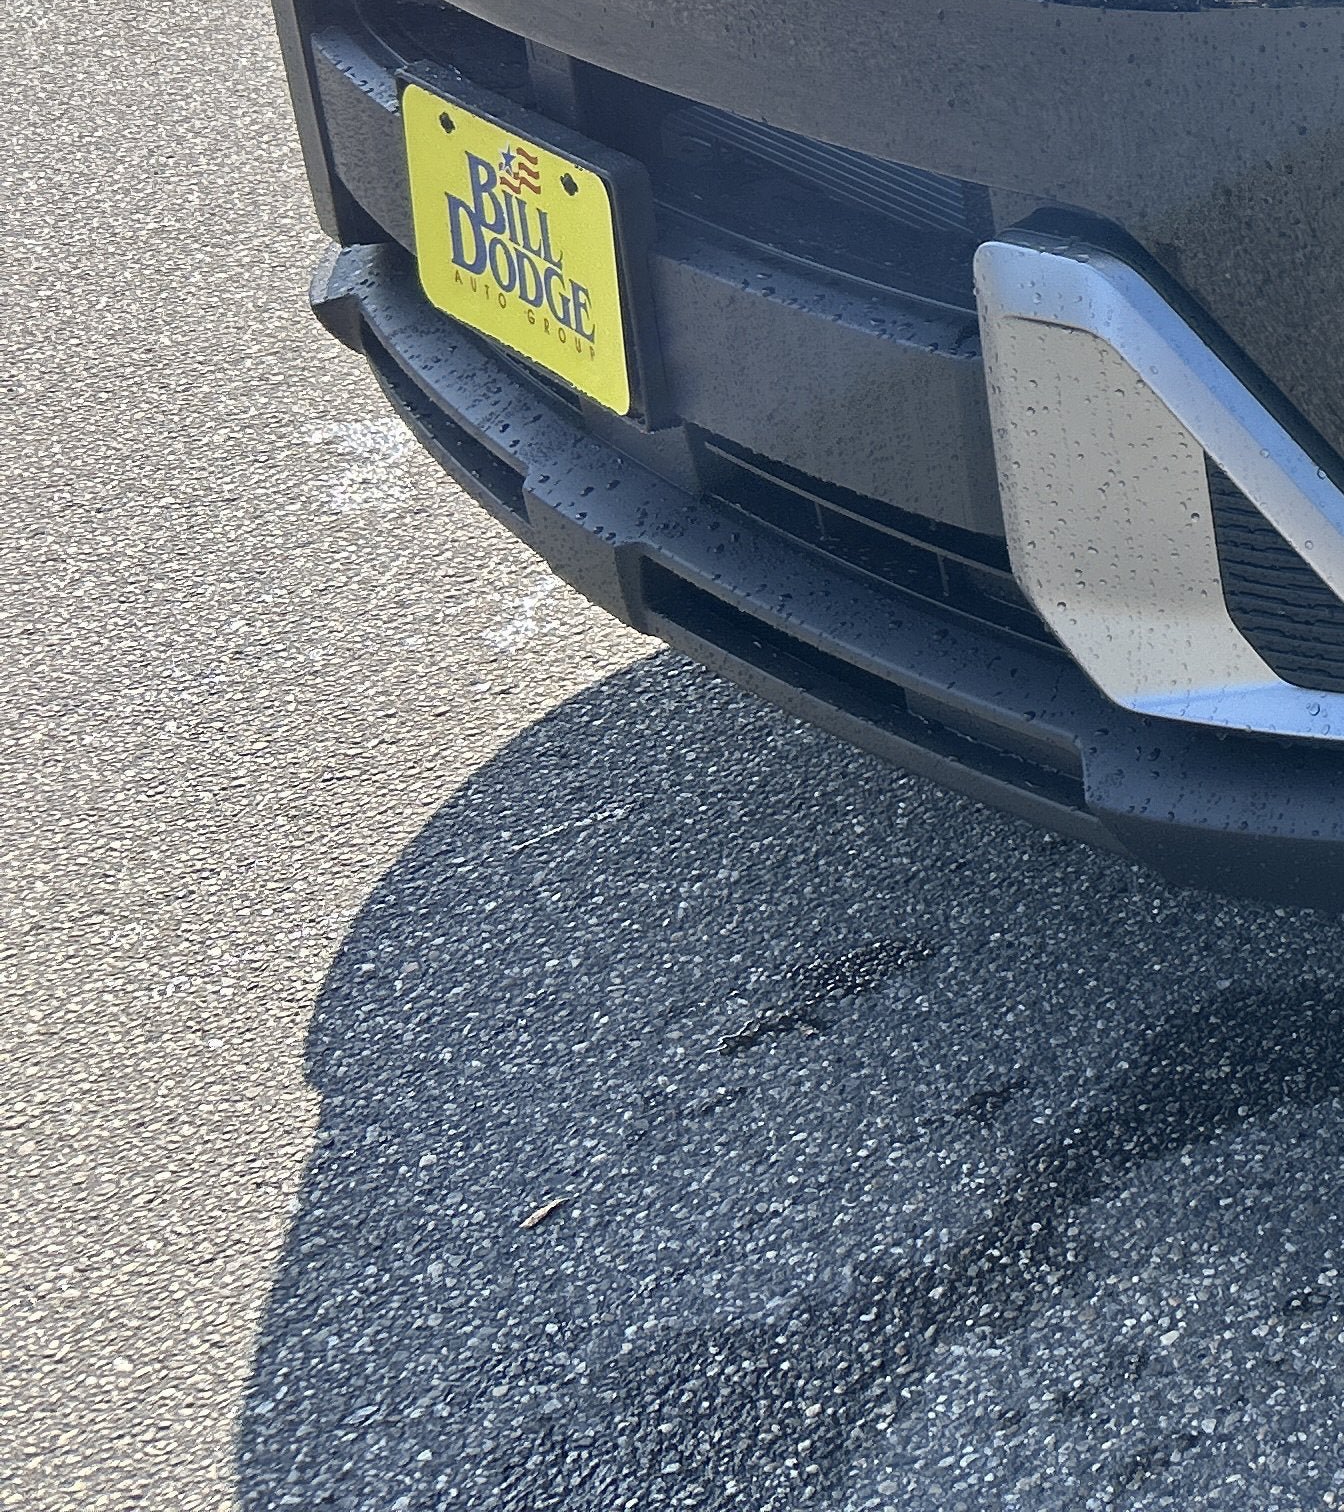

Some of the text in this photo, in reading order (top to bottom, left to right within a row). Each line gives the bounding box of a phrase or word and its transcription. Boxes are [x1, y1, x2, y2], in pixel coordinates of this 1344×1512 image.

[465, 150, 563, 267] BILL
[445, 191, 595, 344] DODGE
[454, 268, 596, 362] AUTO GROUP
